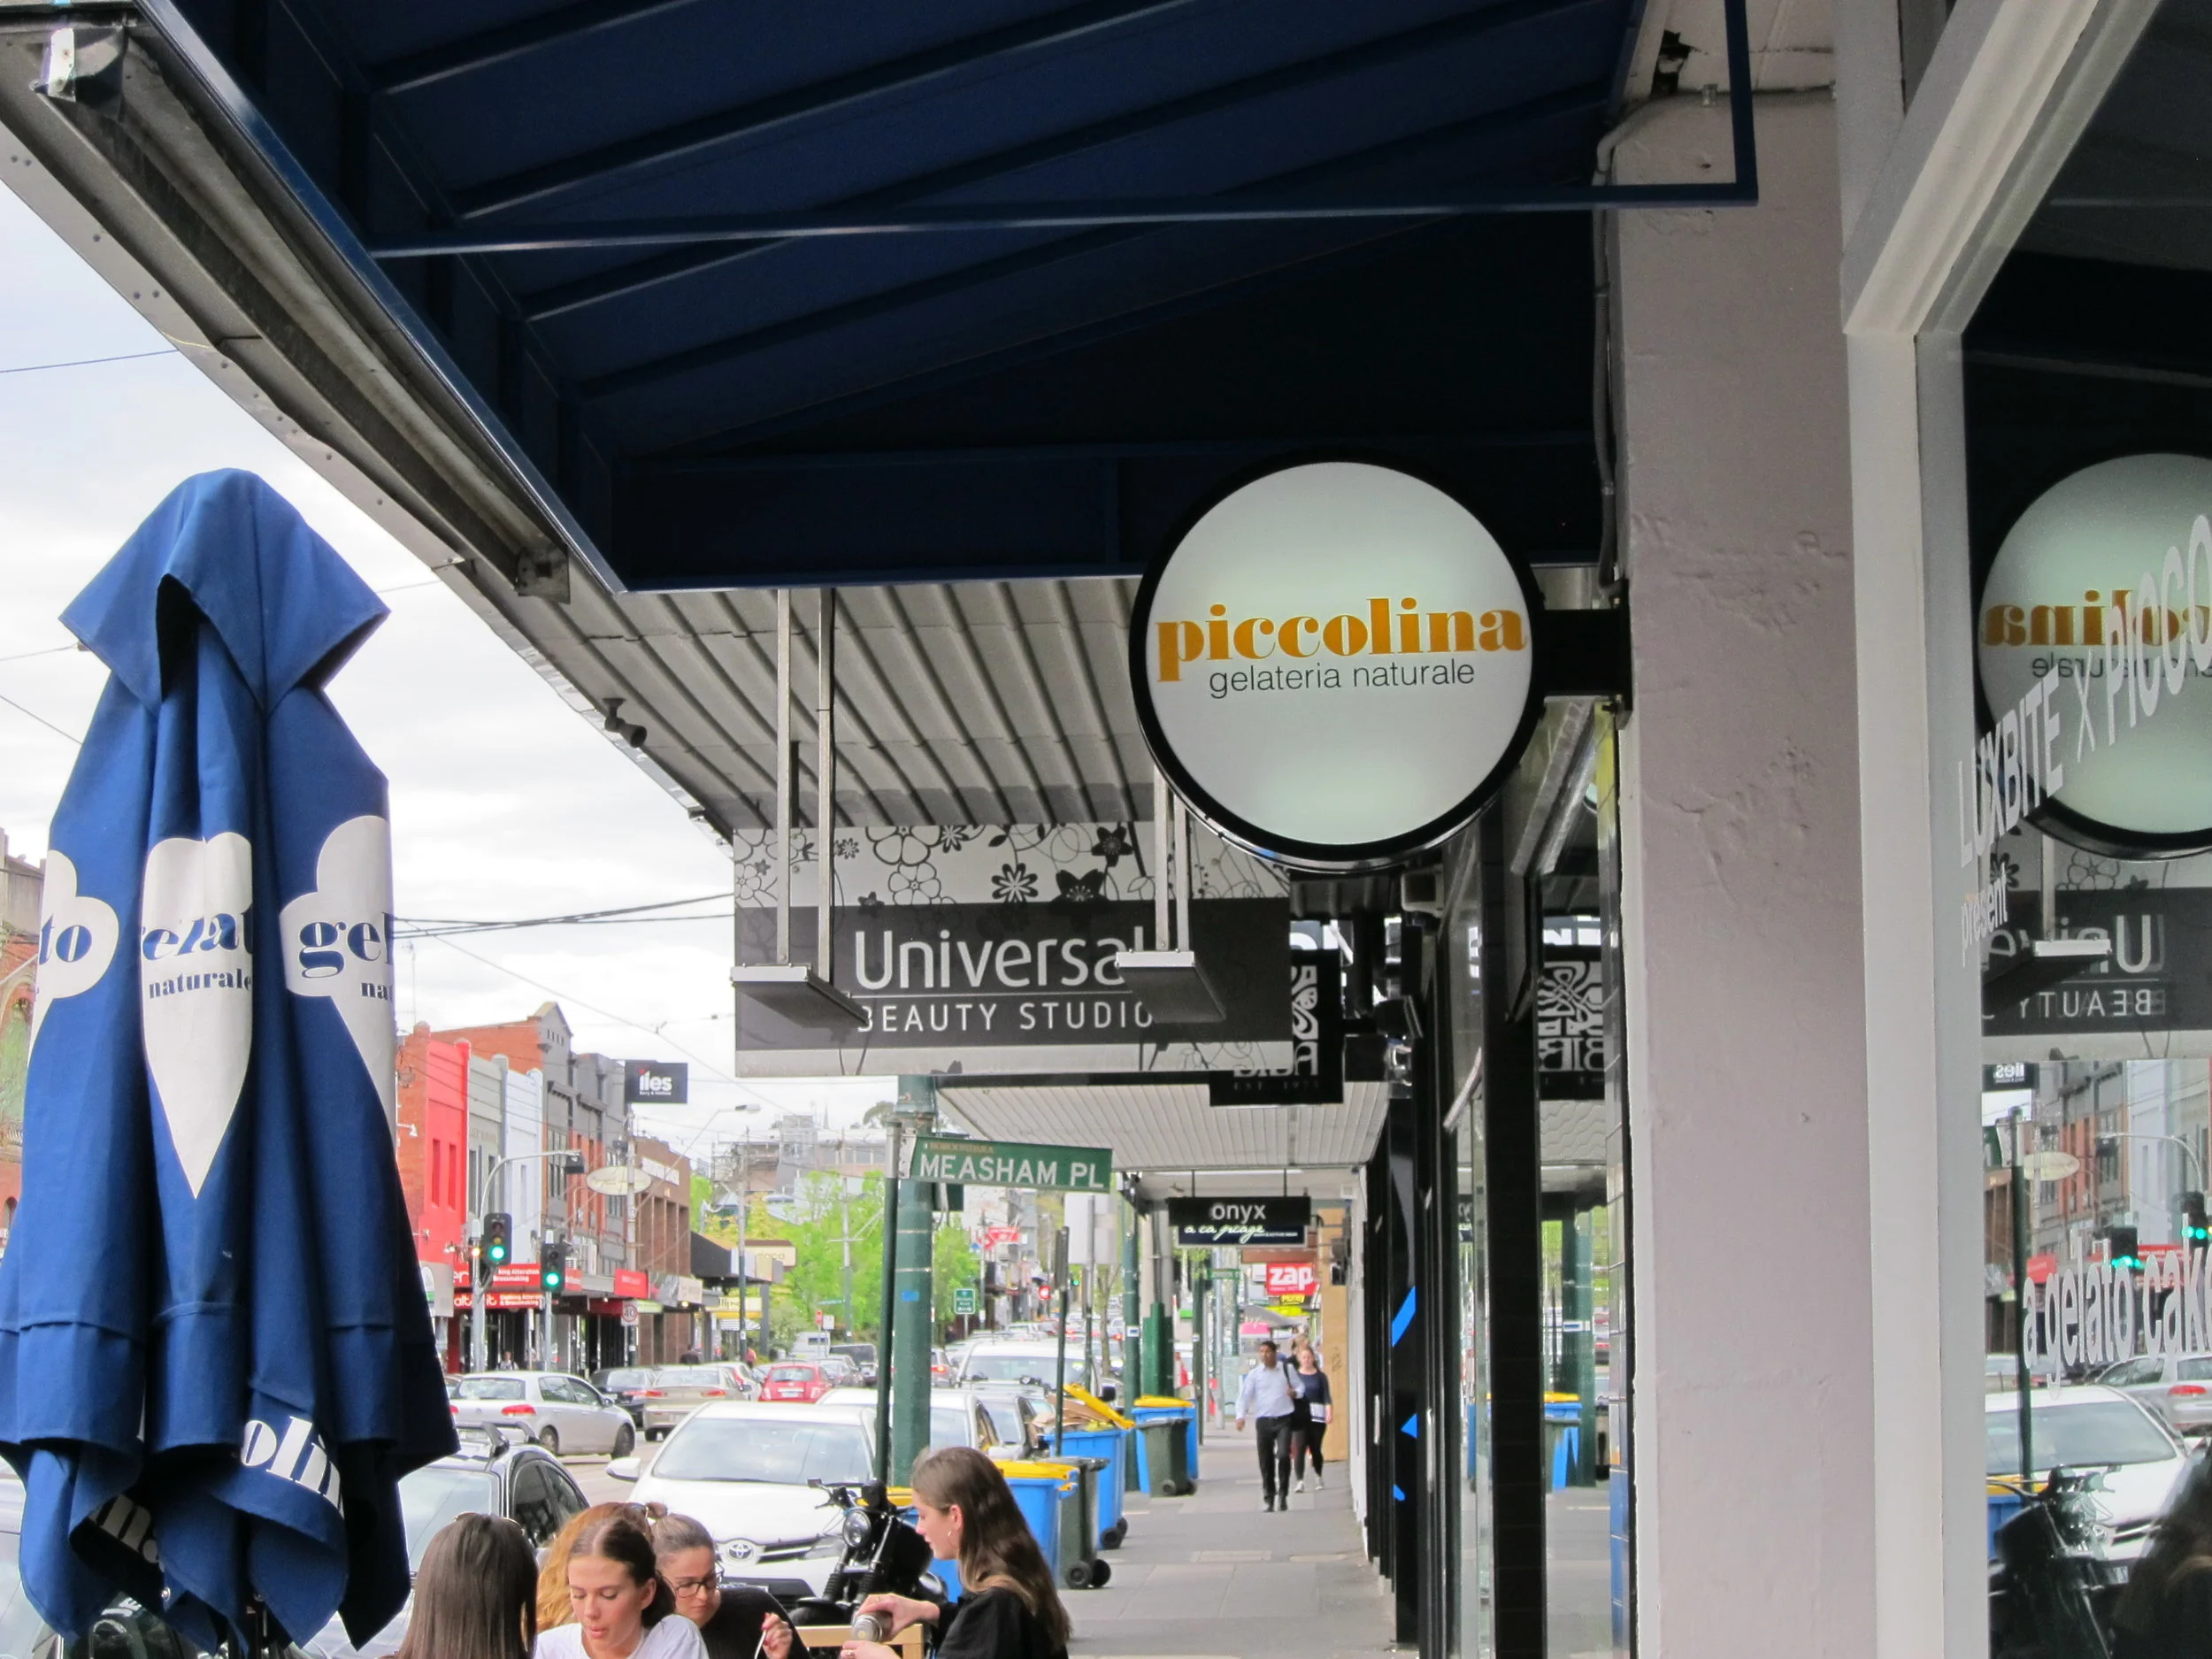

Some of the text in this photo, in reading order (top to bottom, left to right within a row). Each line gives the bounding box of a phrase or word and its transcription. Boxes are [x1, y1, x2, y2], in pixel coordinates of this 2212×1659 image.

[1156, 597, 1529, 683] piccolina
[1209, 658, 1475, 699] gelateria naturale
[1958, 664, 2063, 868] LUXBITE
[1019, 1001, 1154, 1030] STUDIO
[919, 1153, 1104, 1188] MEASHAM PL
[1211, 1203, 1266, 1225] onyx
[1270, 1266, 1313, 1291] zap
[2023, 1277, 2038, 1369] a
[2045, 1235, 2134, 1400] gelato
